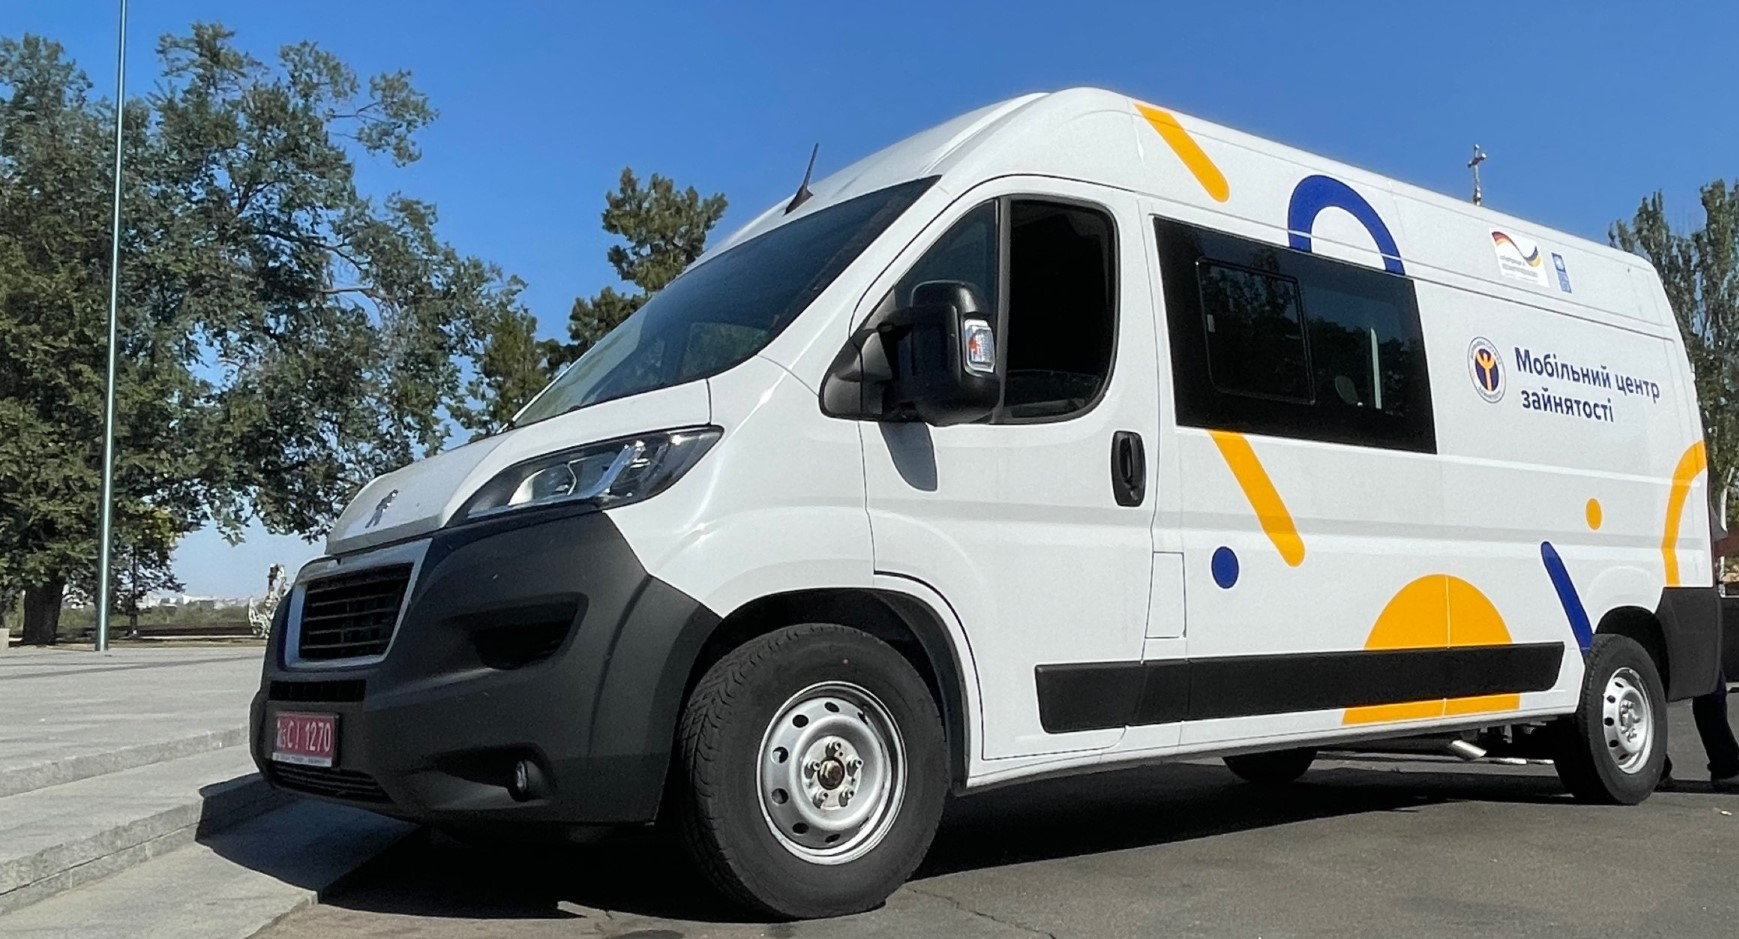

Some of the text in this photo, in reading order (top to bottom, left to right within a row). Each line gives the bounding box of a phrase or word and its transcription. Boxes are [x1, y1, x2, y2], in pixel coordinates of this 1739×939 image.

[1514, 347, 1611, 389] Мобільний
[1615, 374, 1660, 403] центр
[1521, 387, 1614, 422] зайнятості
[305, 721, 332, 752] 1270
